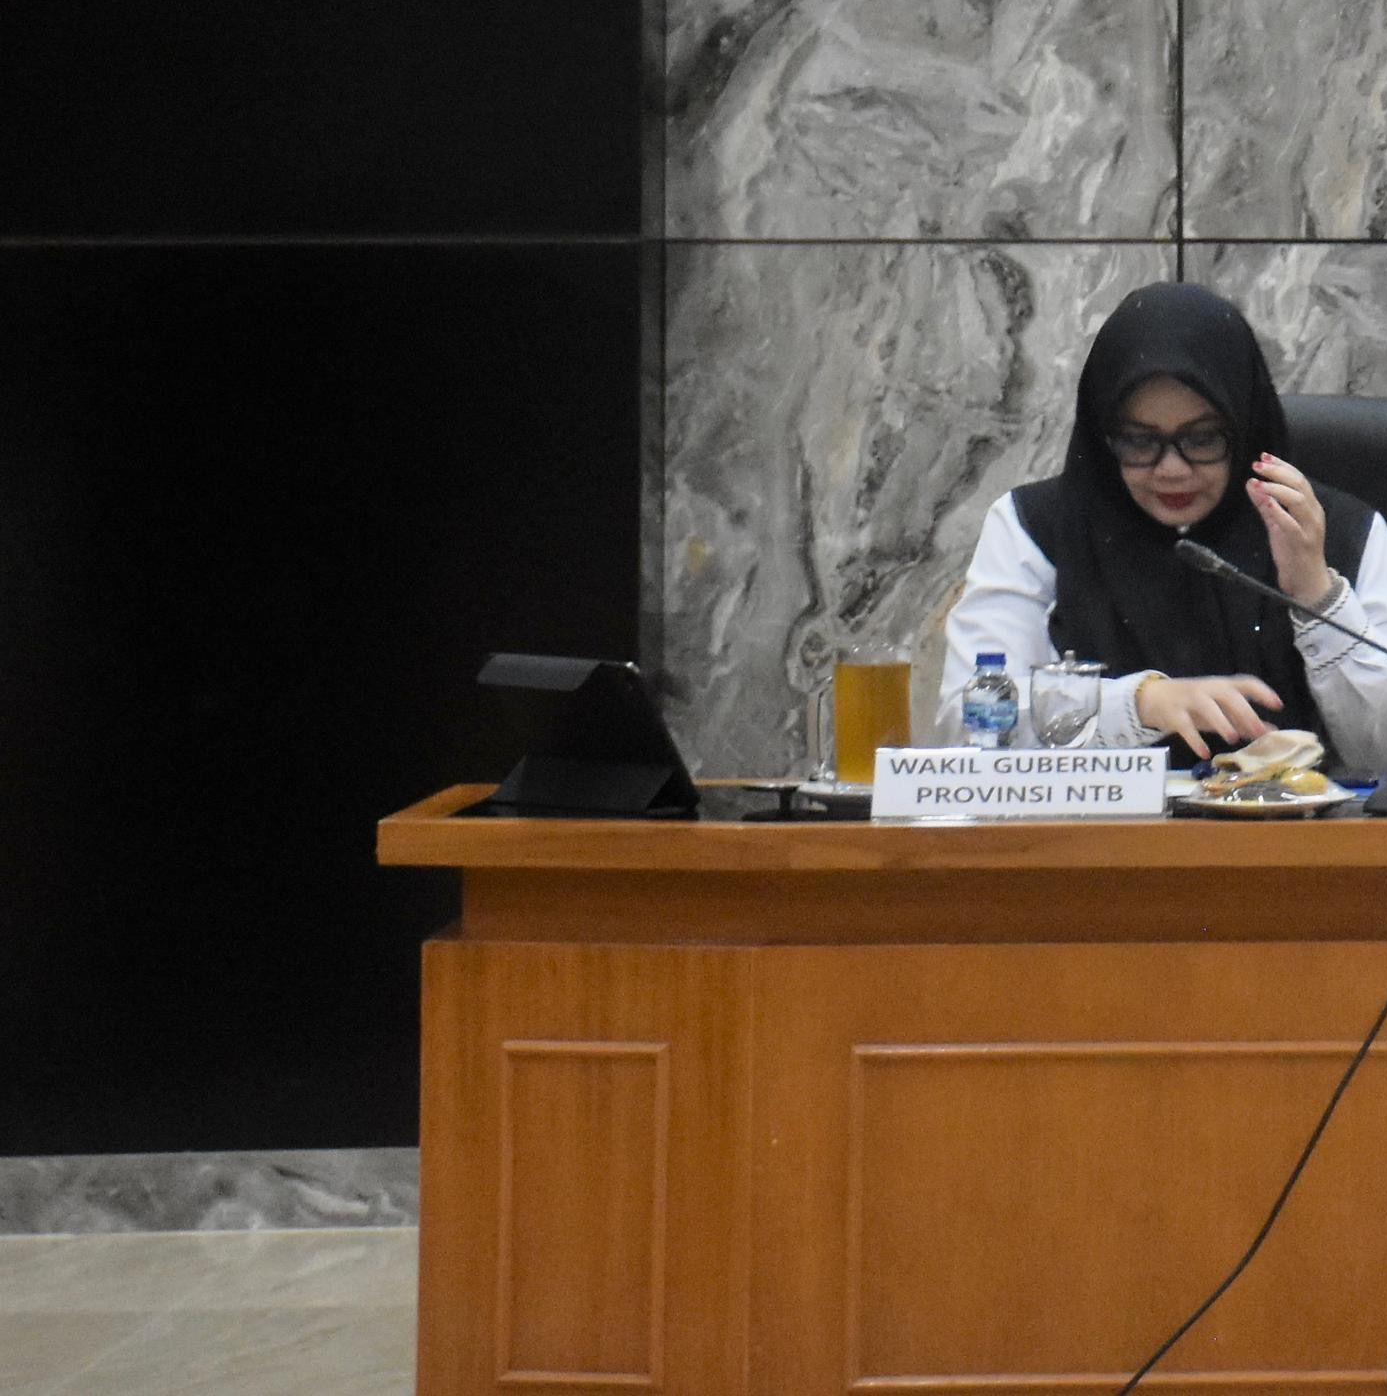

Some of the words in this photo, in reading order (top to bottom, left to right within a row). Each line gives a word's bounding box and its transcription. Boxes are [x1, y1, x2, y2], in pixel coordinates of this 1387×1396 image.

[889, 757, 982, 775] WAKIL
[993, 755, 1154, 773] GUBERNUR
[915, 786, 1053, 804] PROVINSI
[1065, 784, 1124, 803] NTB
